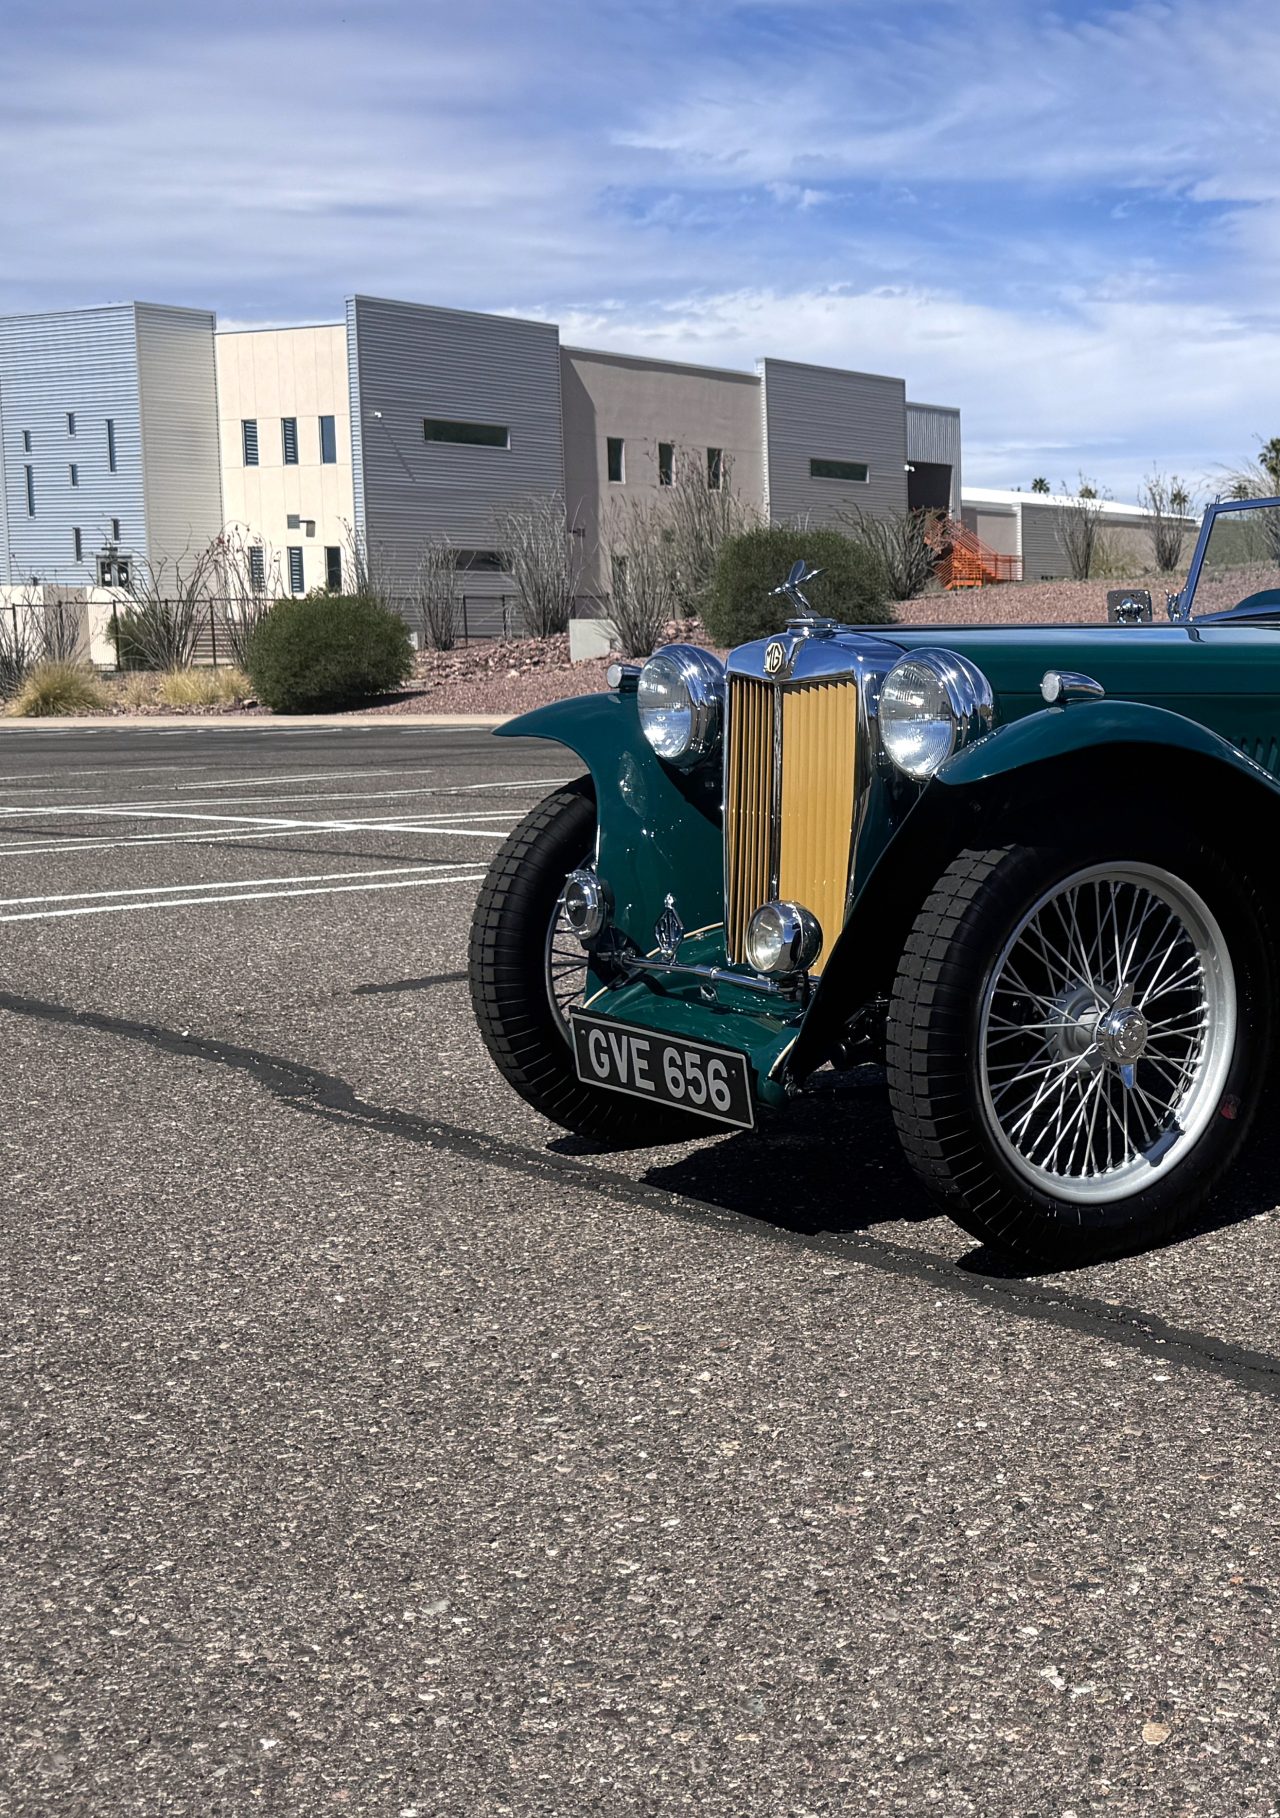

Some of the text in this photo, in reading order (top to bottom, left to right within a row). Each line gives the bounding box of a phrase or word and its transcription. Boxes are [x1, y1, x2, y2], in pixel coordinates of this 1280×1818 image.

[766, 643, 782, 671] MG
[588, 1028, 731, 1111] GVE 656
